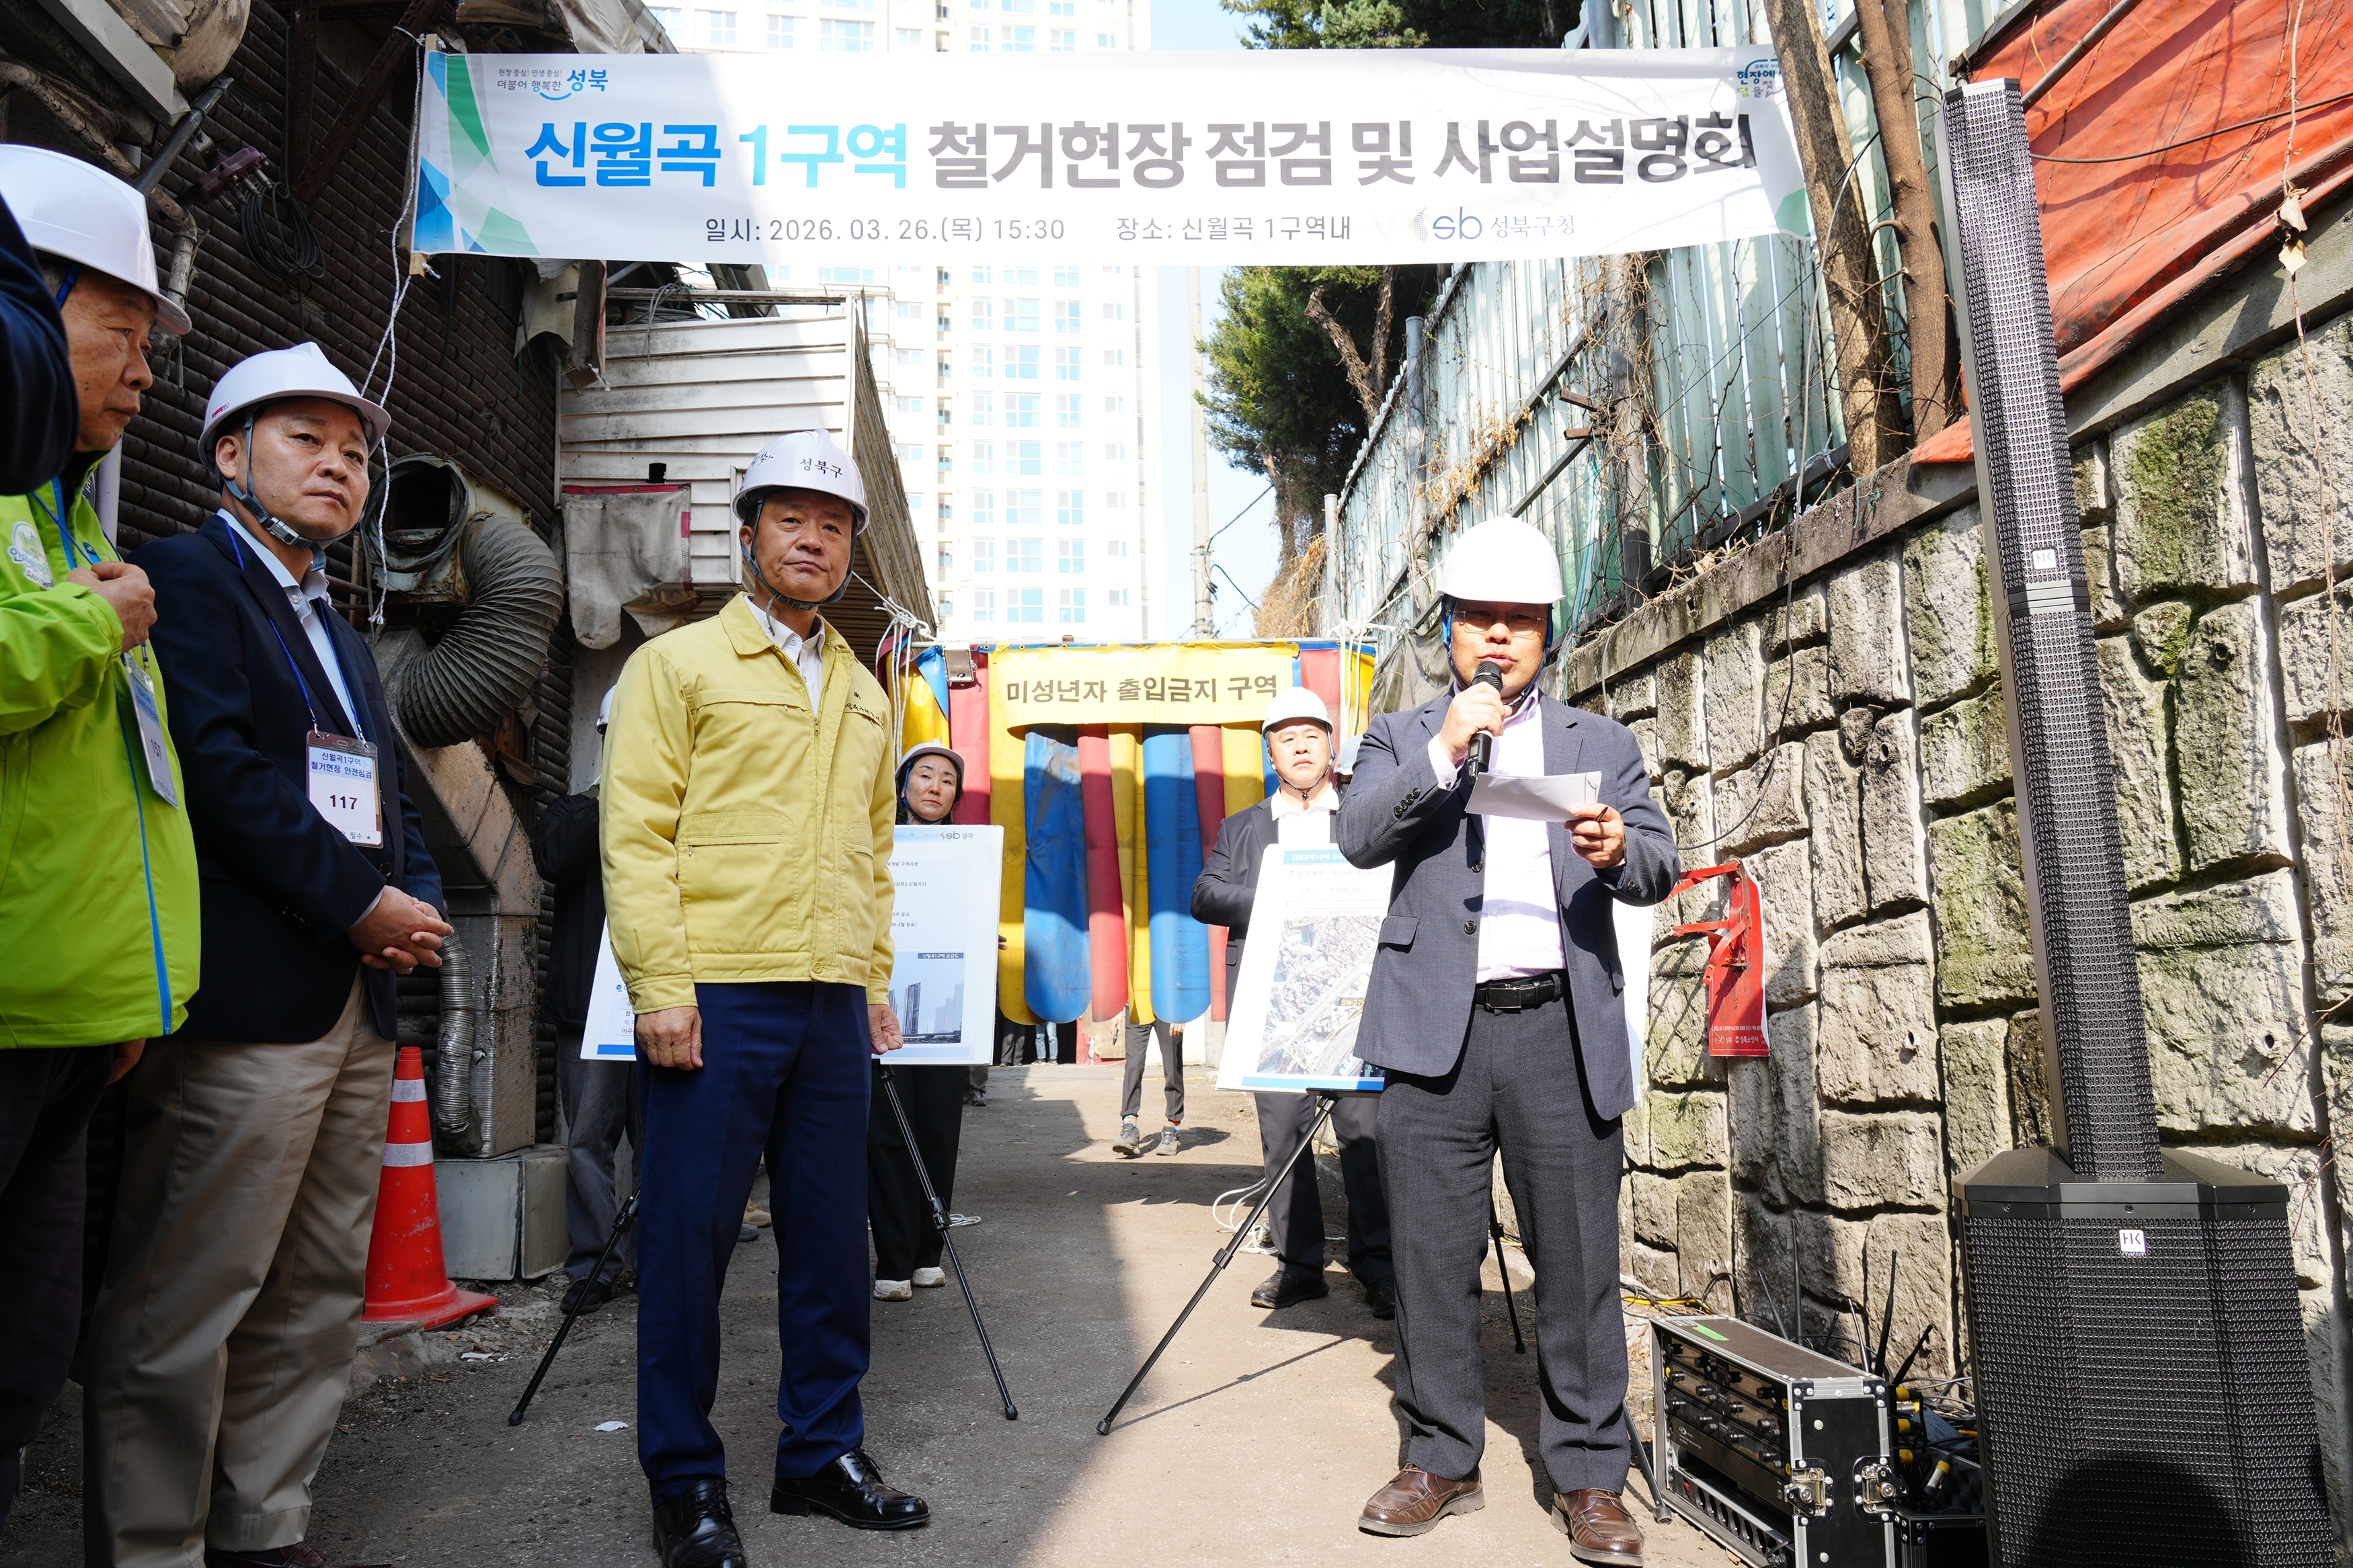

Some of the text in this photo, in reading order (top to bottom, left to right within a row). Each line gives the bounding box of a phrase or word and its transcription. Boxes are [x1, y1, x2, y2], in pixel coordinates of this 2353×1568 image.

[499, 69, 512, 77] 현장
[514, 69, 530, 77] 중심!
[547, 69, 563, 78] 중심!
[567, 69, 608, 92] 성북
[497, 79, 563, 93] 더불어 행복한
[524, 110, 1757, 190] 신월곡 1구역 철거현장 점검 및 사업설명회
[705, 216, 1066, 243] 일시: 2026. 03. 26.(목) 15:30
[1116, 215, 1351, 241] 장소: 신월곡 1구역내
[1433, 206, 1574, 240] sb 성북구청
[798, 458, 843, 479] 성북구
[2036, 551, 2053, 564] HK
[1006, 674, 1277, 704] 미성년자 출입금지 구역
[150, 737, 163, 761] 157
[321, 751, 362, 766] 신월곡1구역
[311, 761, 372, 779] 철거현장 안전점검
[329, 794, 358, 810] 117
[350, 831, 363, 840] 필수
[946, 830, 961, 839] sb
[2122, 1233, 2142, 1245] HK
